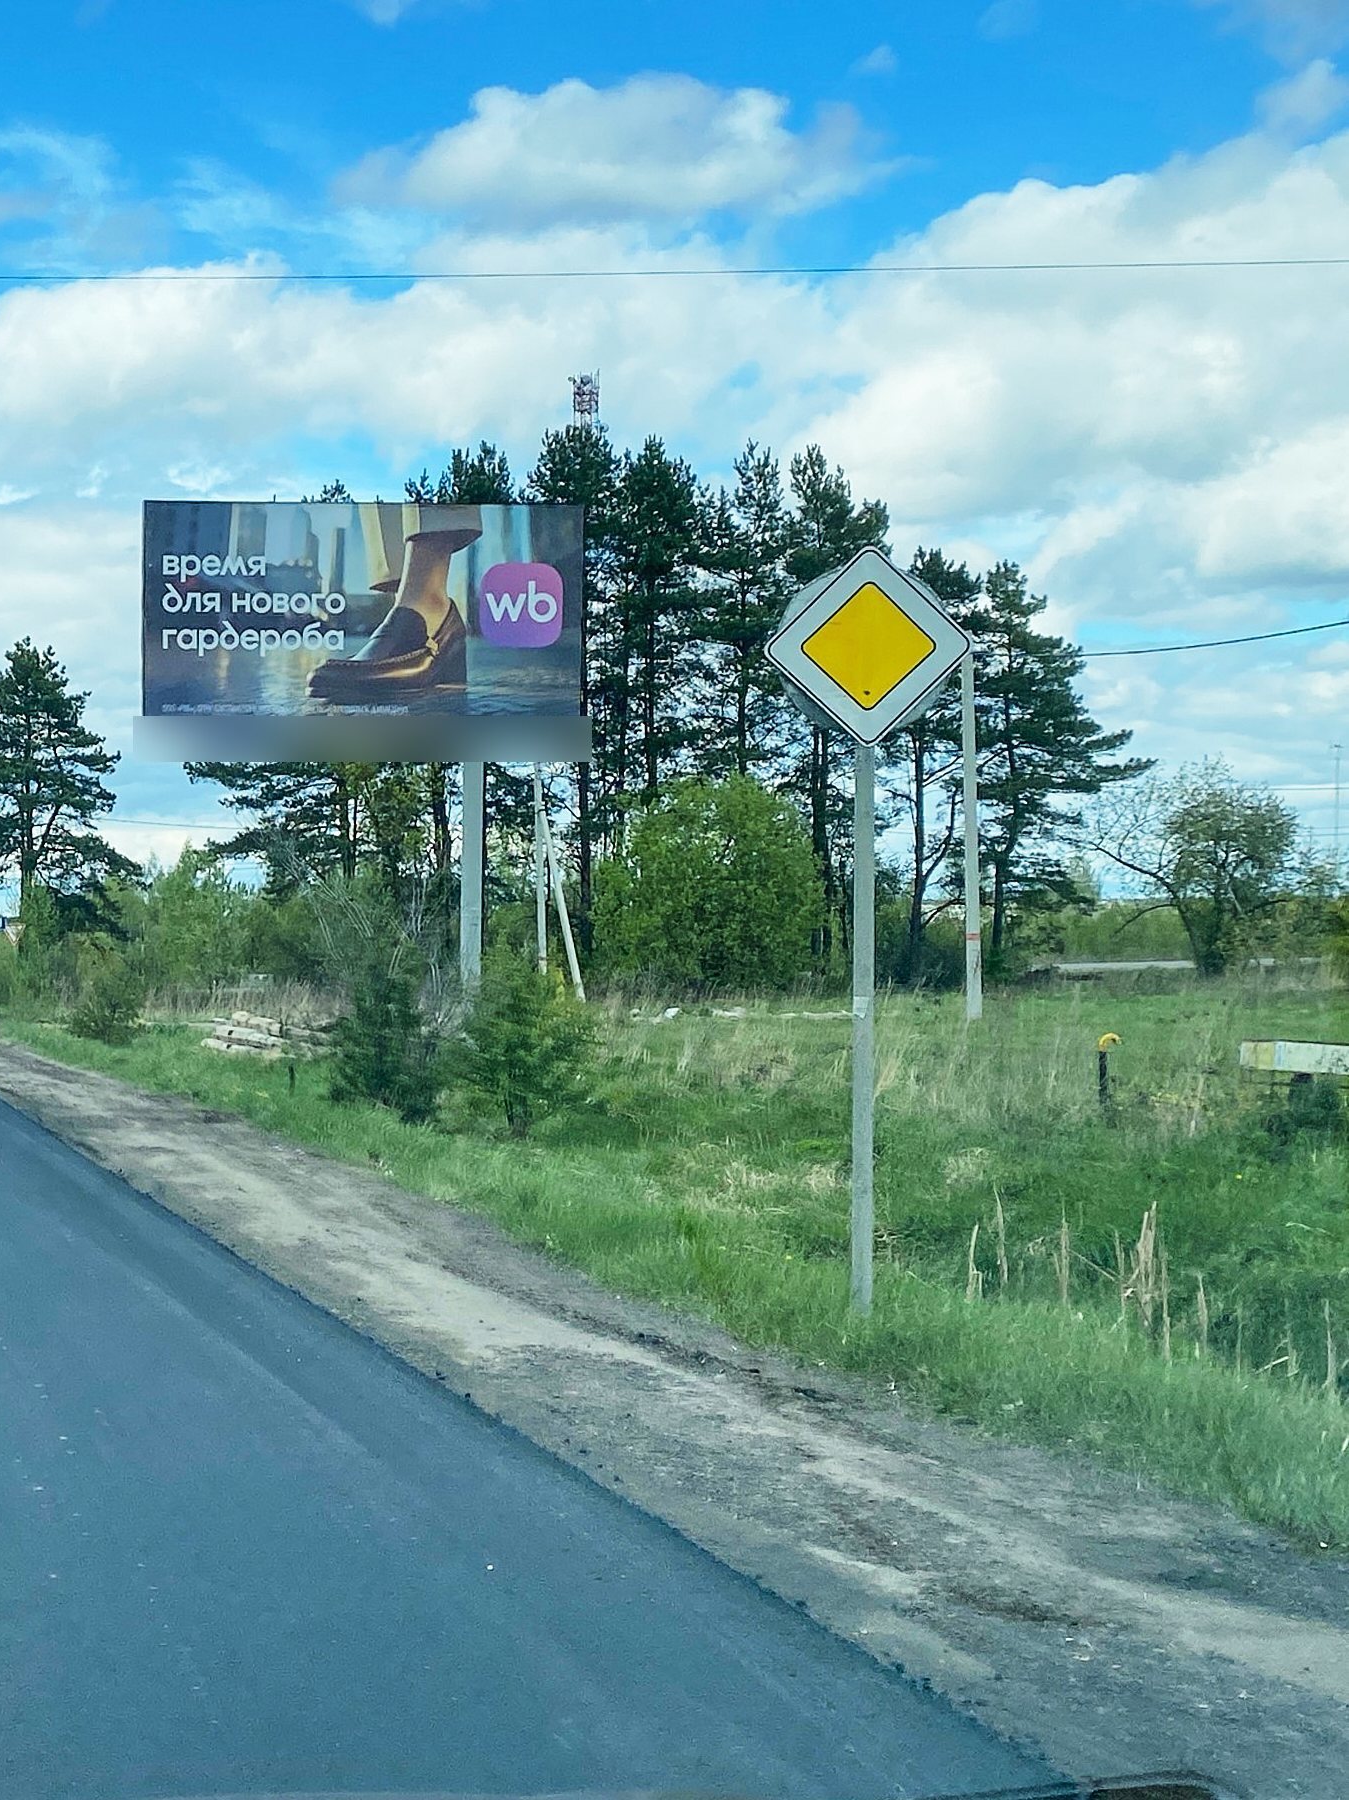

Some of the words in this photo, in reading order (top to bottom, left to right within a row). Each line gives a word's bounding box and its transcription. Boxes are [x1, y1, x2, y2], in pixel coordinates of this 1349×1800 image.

[162, 554, 266, 582] время
[162, 583, 220, 613] для
[232, 592, 346, 614] нового
[485, 580, 558, 623] wb
[162, 620, 345, 657] гардероба
